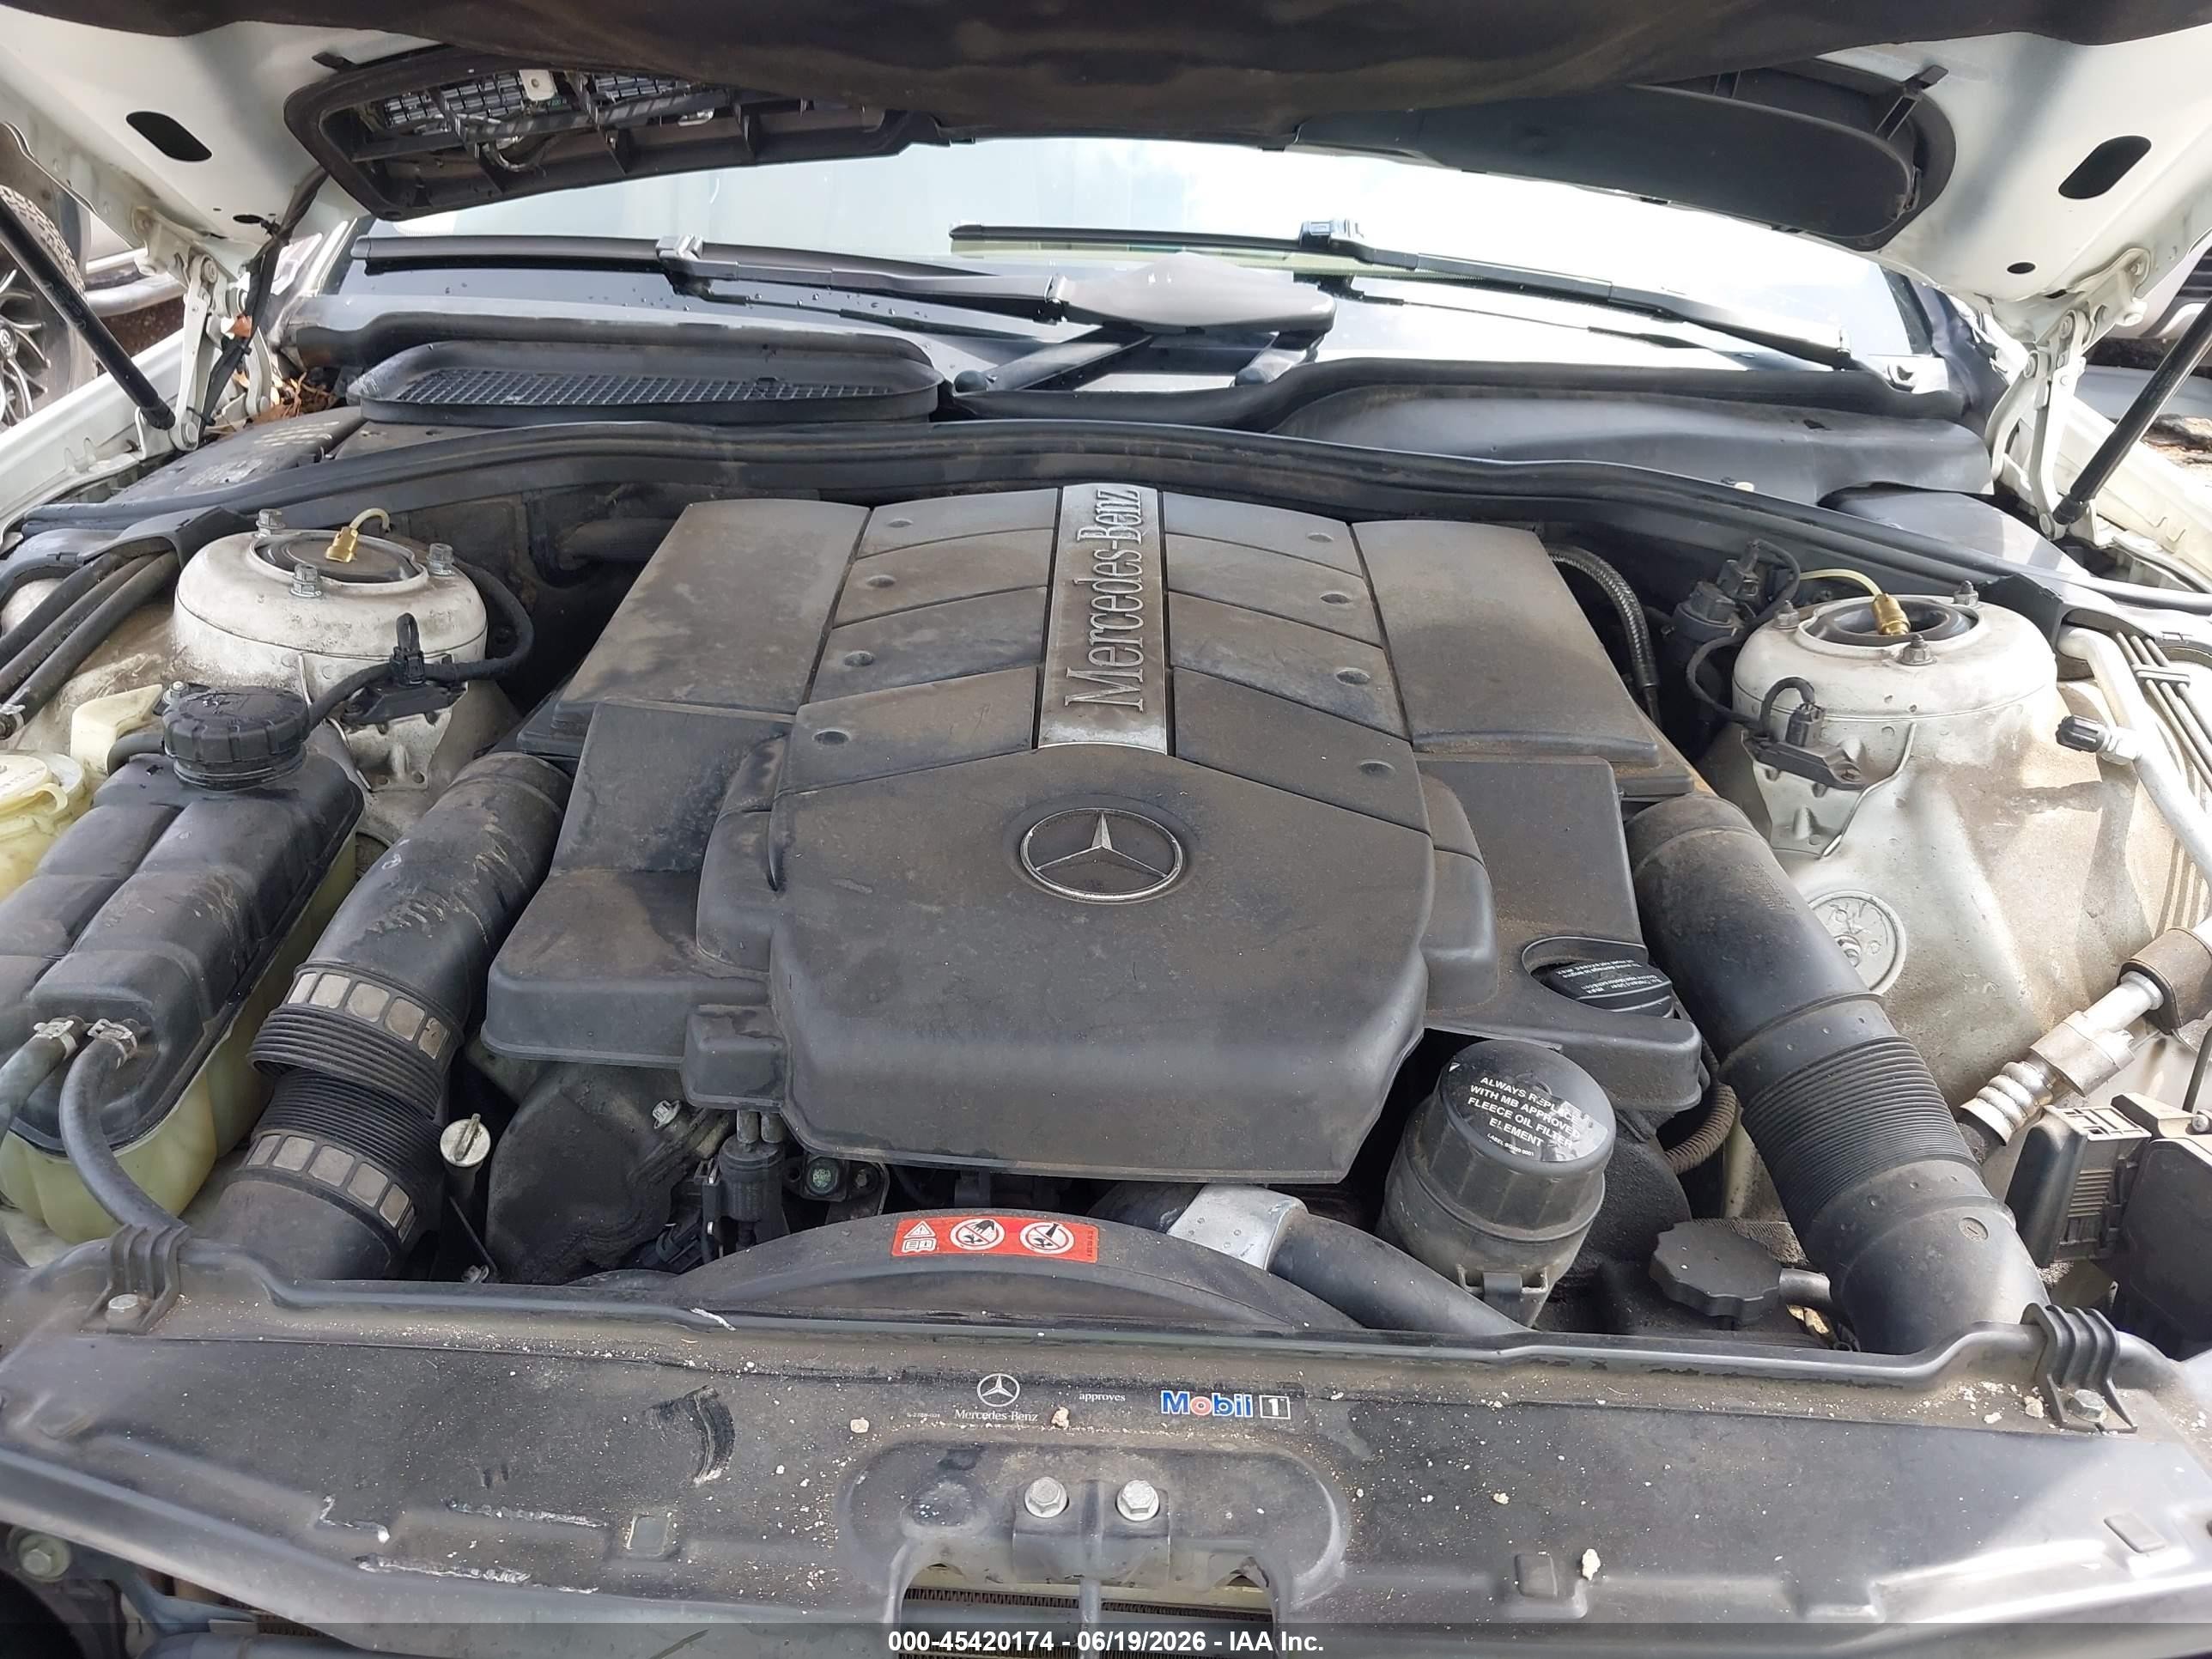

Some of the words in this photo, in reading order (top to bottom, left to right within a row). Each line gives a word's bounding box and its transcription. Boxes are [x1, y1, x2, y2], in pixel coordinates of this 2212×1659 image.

[1064, 488, 1144, 714] Mercedes-Benz
[1480, 1077, 1526, 1097] ALWAYS
[1468, 1097, 1513, 1120] FLEECE
[1515, 1114, 1534, 1128] OIL
[1535, 1123, 1573, 1149] FILTER
[1470, 1085, 1499, 1100] WITH
[1500, 1095, 1520, 1108] MB
[1520, 1103, 1580, 1139] APPROVED
[1489, 1117, 1544, 1146] ELEMENT
[1079, 1391, 1126, 1403] approves
[1160, 1390, 1254, 1419] Mobil
[955, 1409, 1038, 1422] Mercedes-Benz
